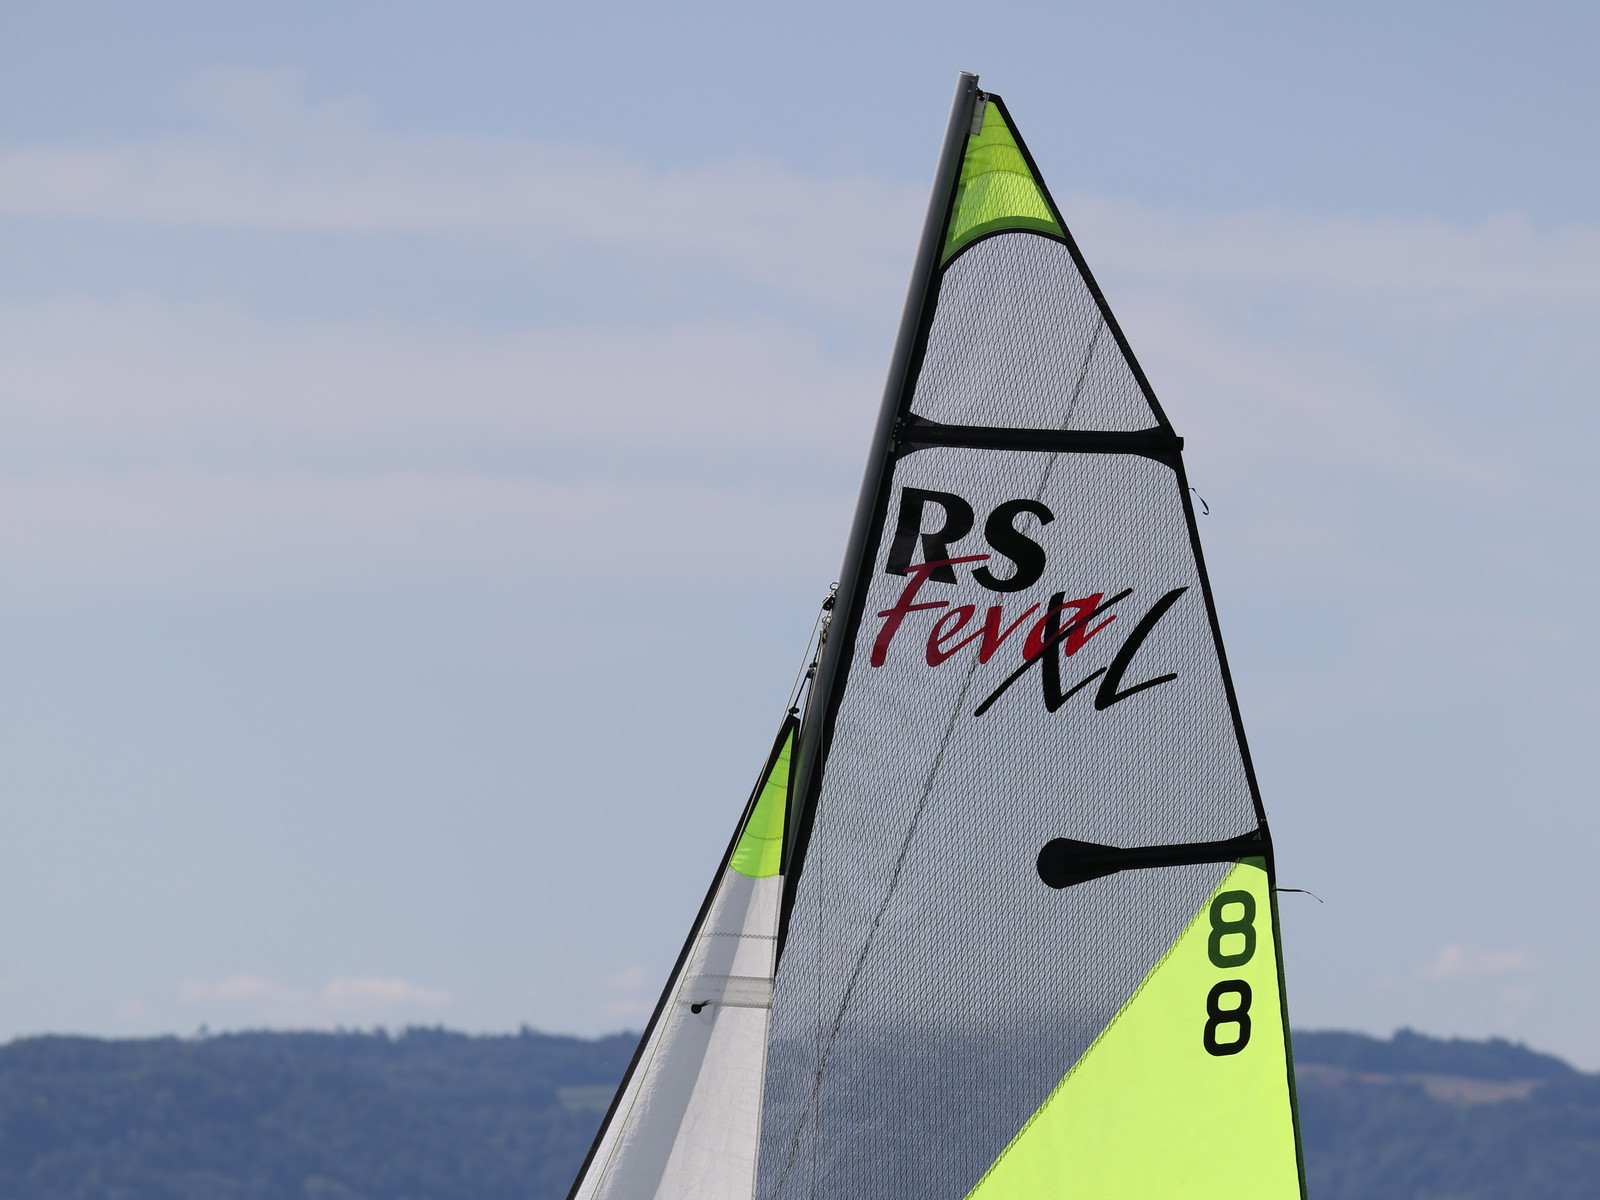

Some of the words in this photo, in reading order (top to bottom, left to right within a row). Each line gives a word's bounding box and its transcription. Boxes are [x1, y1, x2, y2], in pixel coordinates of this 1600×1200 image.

[885, 486, 1055, 593] RS
[870, 554, 1117, 668] Feva
[974, 586, 1190, 717] XL
[1208, 890, 1257, 969] 8
[1203, 979, 1252, 1057] 8
